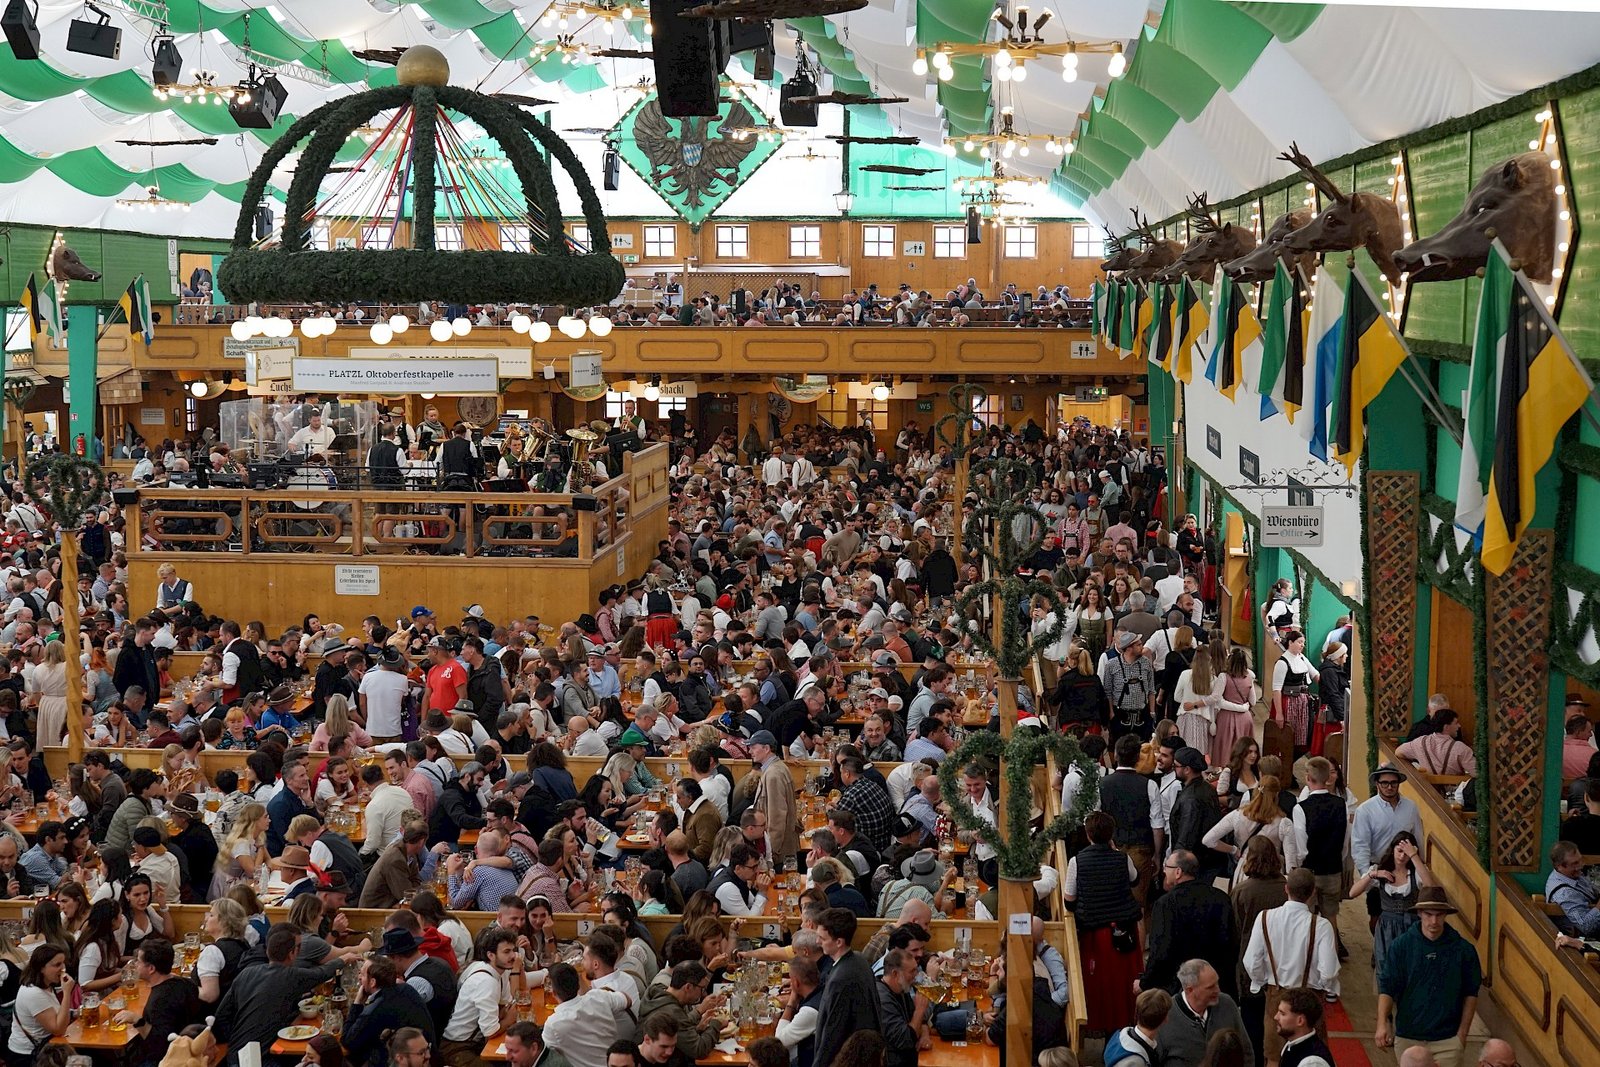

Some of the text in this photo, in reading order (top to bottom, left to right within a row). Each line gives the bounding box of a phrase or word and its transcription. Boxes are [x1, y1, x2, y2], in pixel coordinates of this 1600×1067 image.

[329, 370, 454, 380] PLATZL Oktoberfestkapelle
[1267, 515, 1319, 527] Wiesnbüro
[1280, 529, 1303, 538] Office
[583, 920, 589, 932] 3
[769, 924, 775, 935] 2
